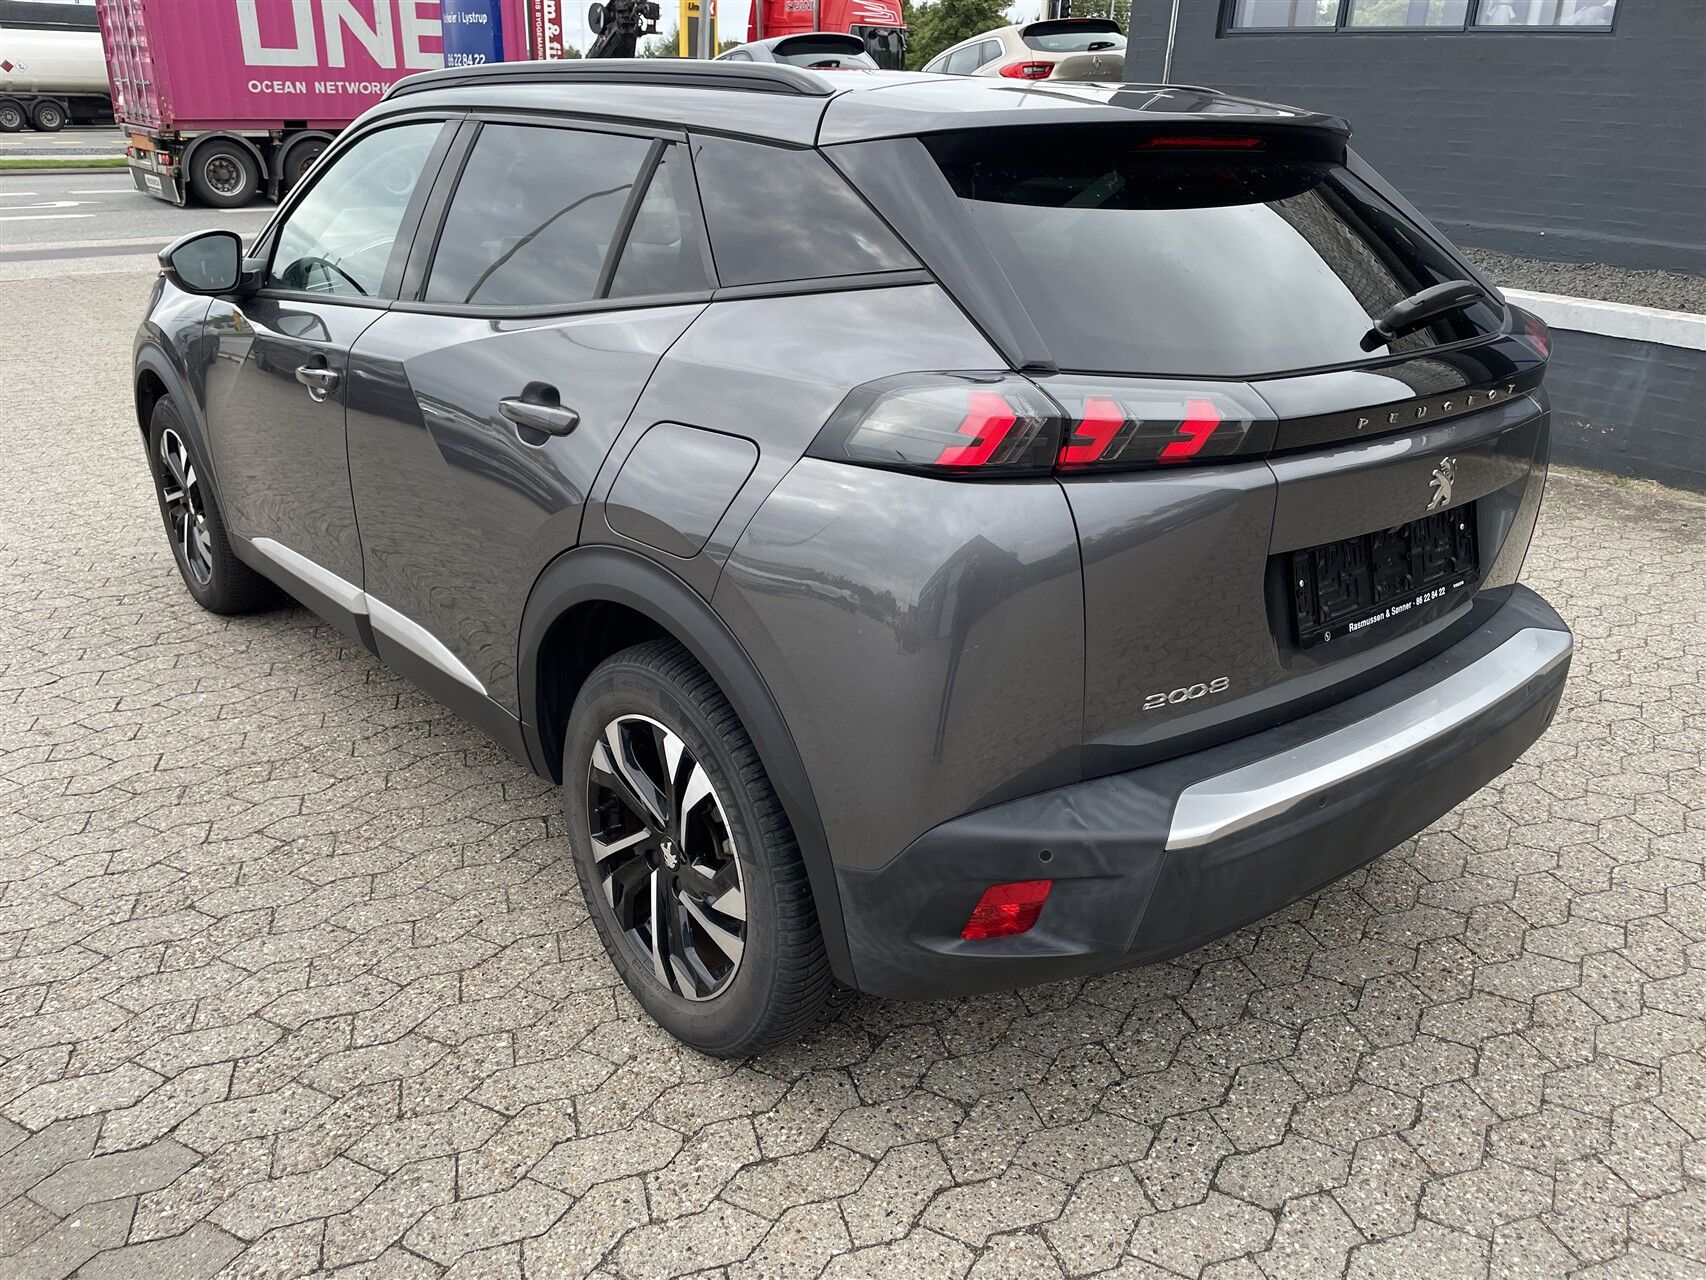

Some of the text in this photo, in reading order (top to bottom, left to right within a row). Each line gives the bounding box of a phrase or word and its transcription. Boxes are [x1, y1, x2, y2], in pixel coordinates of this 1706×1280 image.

[236, 0, 445, 69] ONE
[461, 11, 488, 26] Lystrup
[462, 53, 473, 66] 84
[248, 80, 391, 95] OCEAN NETWORK
[1357, 384, 1515, 430] PEUGEOT
[1348, 612, 1385, 632] Rasmussen
[1438, 586, 1446, 596] 22
[1142, 676, 1230, 711] 2008
